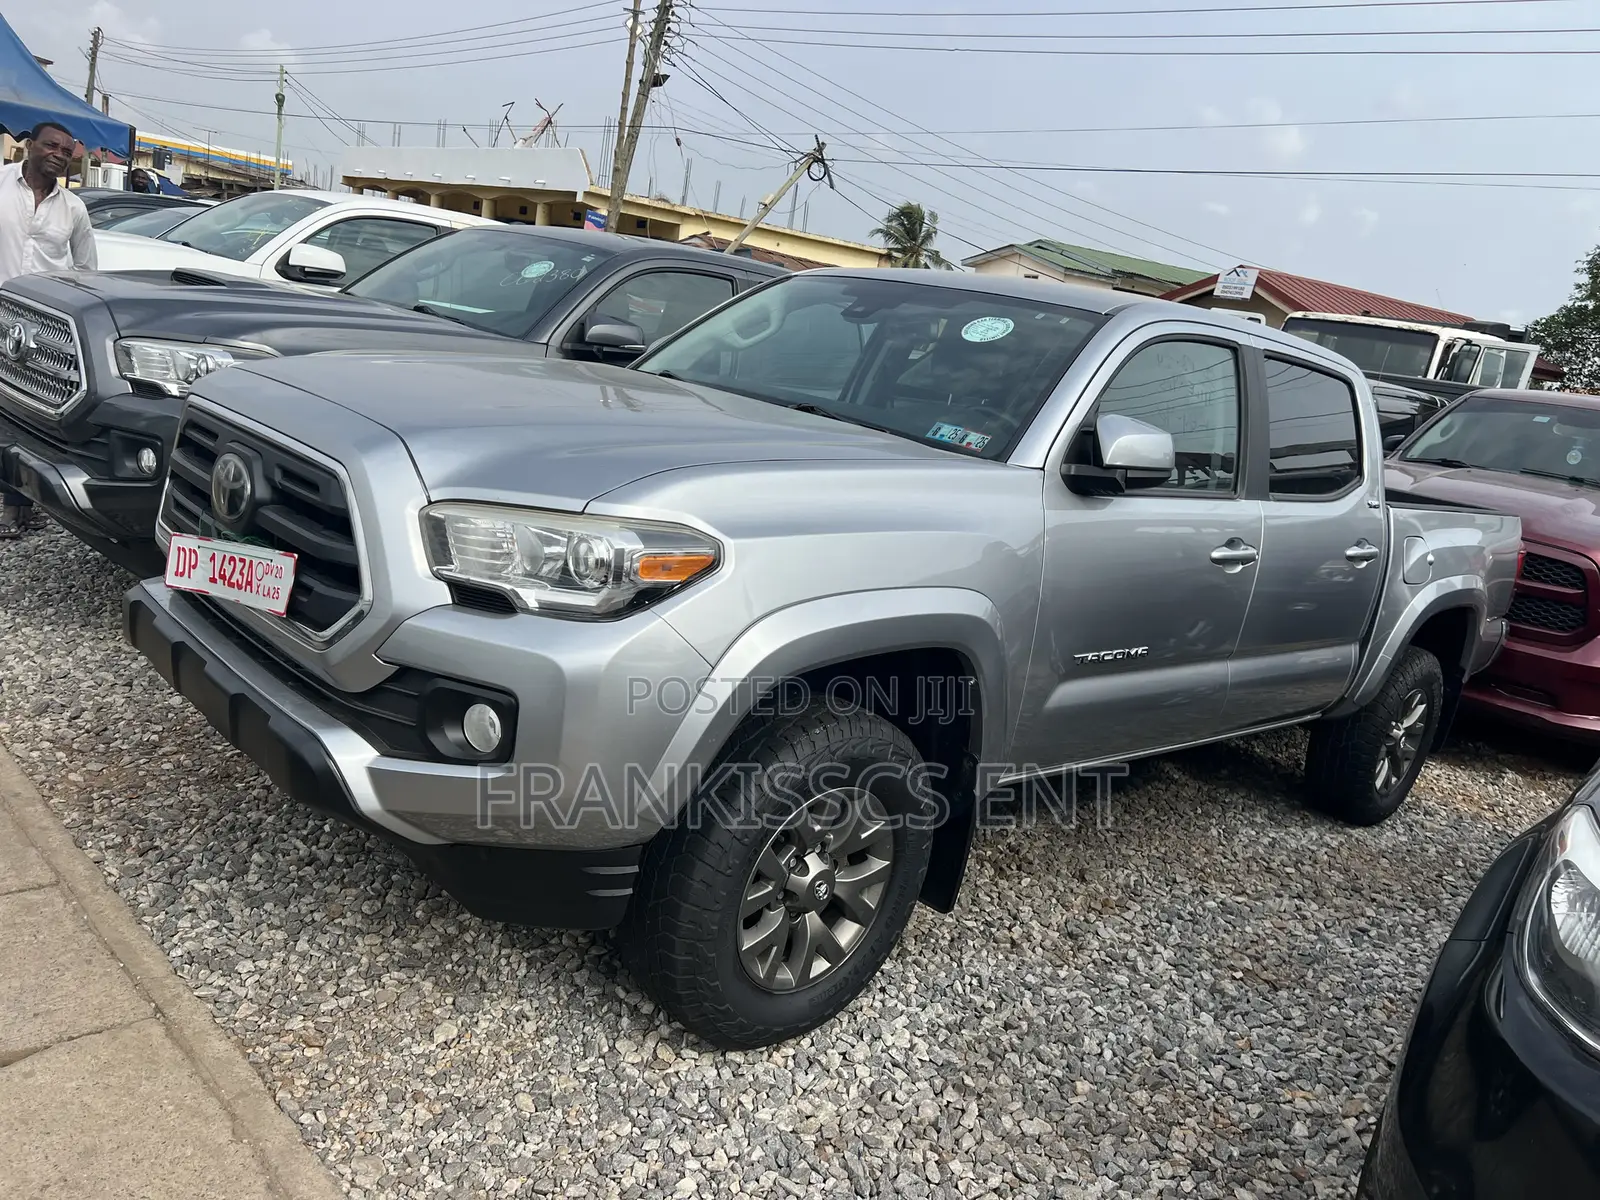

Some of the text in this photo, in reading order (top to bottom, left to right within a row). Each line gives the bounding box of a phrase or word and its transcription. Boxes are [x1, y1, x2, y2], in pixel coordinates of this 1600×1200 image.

[174, 546, 254, 594] DP 1423A
[271, 586, 281, 600] 25
[1073, 646, 1149, 665] TACOMA
